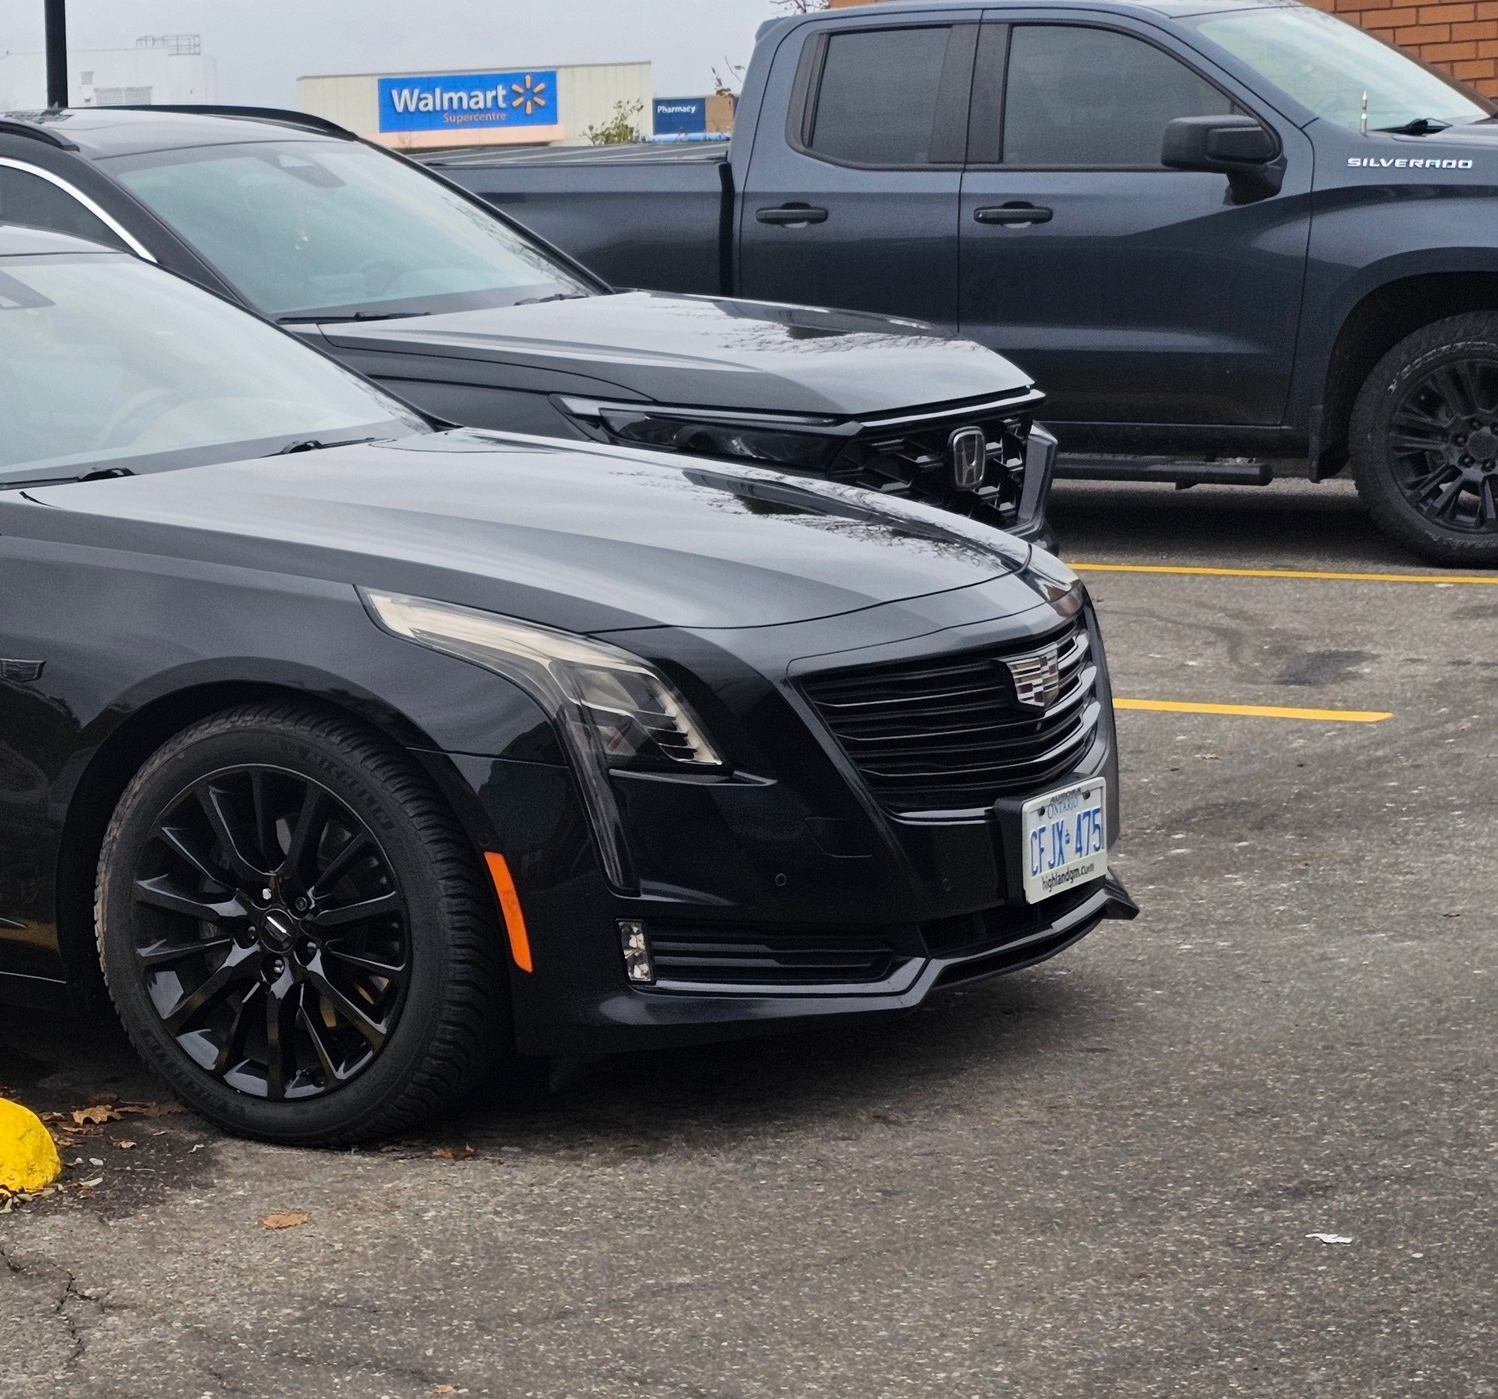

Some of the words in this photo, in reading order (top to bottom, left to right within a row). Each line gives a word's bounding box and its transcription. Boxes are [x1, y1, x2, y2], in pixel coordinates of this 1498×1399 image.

[391, 84, 507, 113] Walmart
[657, 105, 696, 114] Pharmacy
[442, 112, 507, 124] Supercentre
[1346, 157, 1473, 169] SILVERADO
